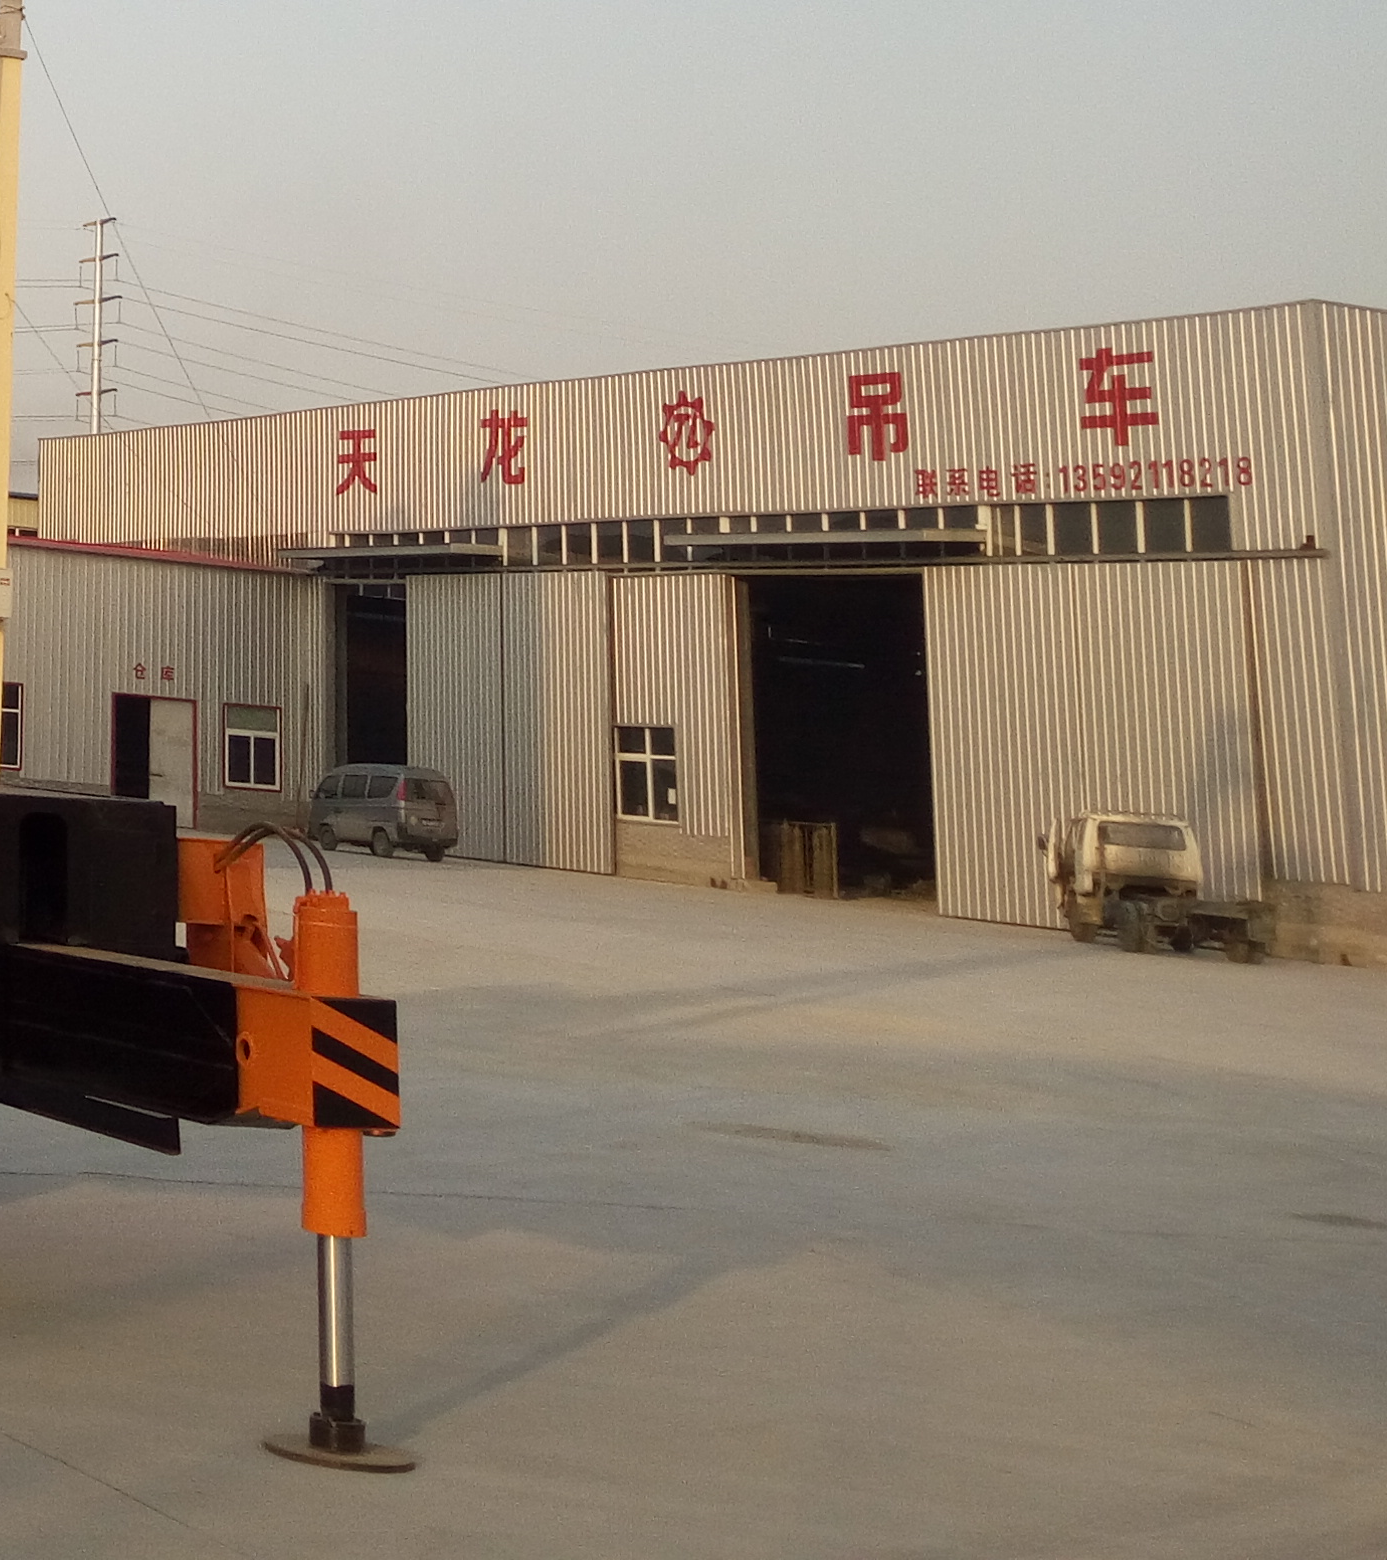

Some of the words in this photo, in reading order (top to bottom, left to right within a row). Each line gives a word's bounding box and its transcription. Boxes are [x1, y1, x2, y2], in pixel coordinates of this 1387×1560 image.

[915, 456, 1253, 499] 联系电话:13592118218
[133, 662, 175, 682] 仓库
